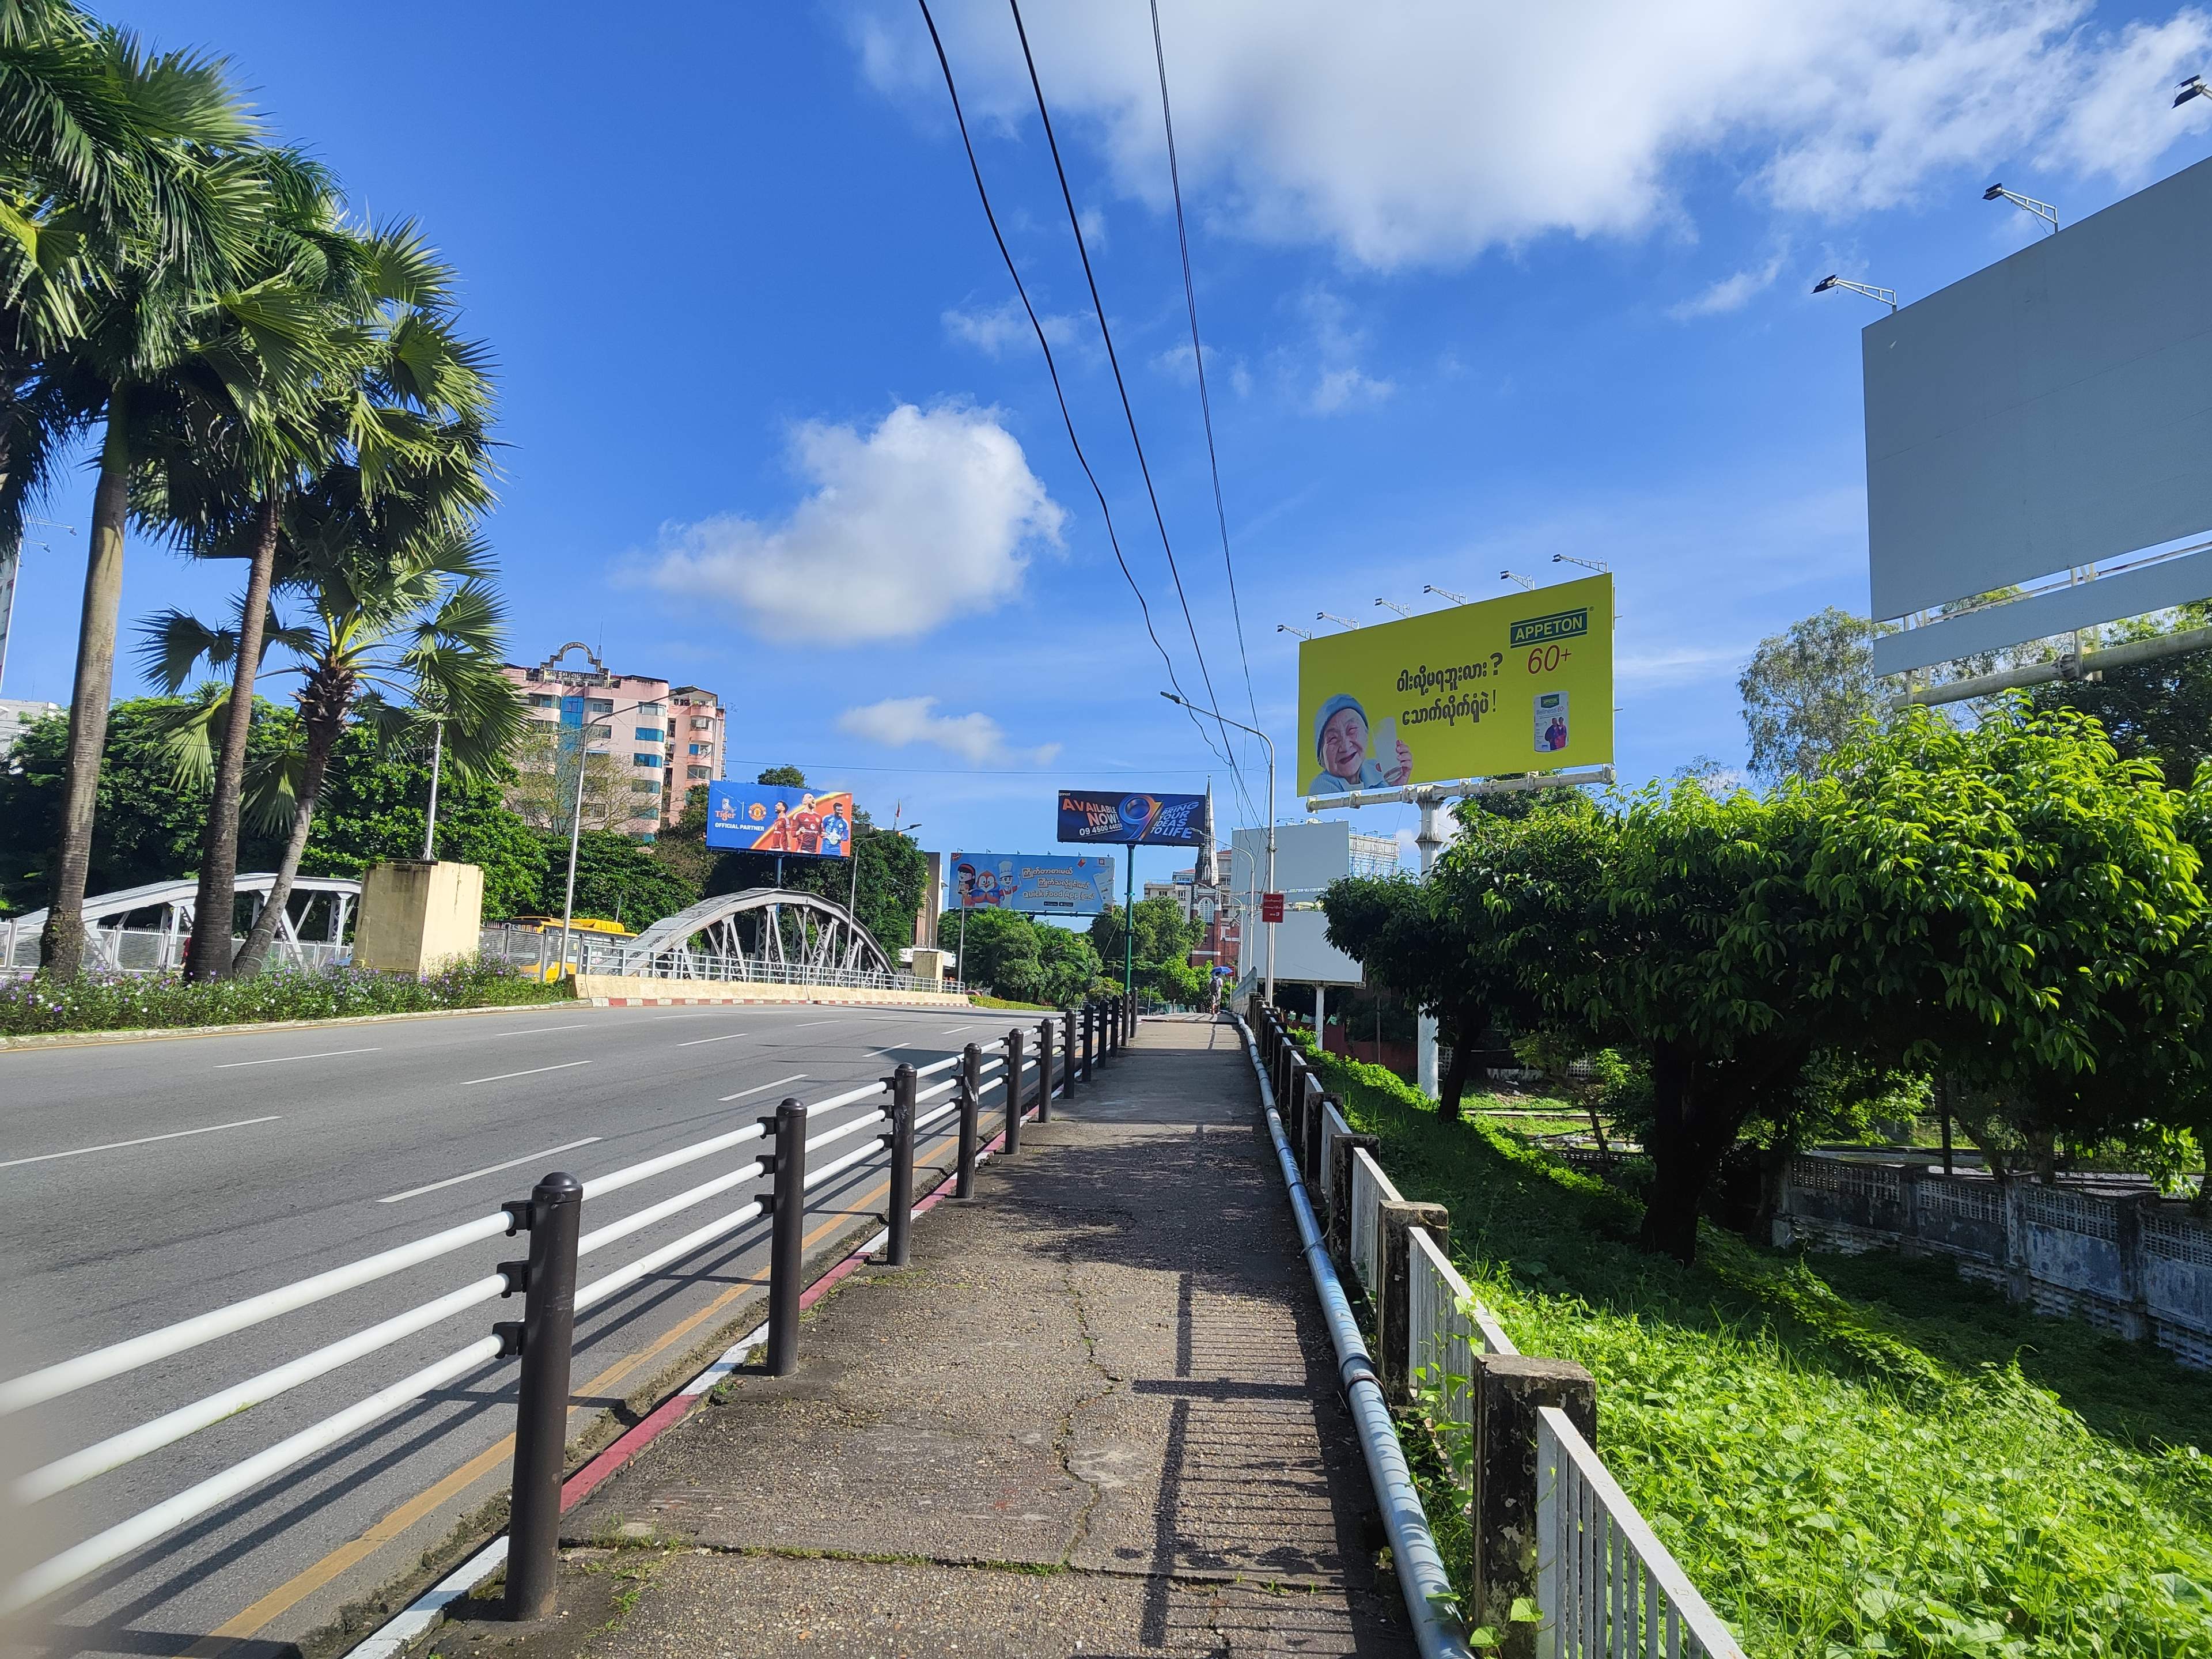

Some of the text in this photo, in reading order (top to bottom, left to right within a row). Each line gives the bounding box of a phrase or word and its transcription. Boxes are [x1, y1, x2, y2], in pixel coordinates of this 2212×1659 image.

[1515, 616, 1583, 641] APPETON
[1528, 645, 1572, 675] 60+
[1062, 798, 1117, 813] AVAILABLE
[1161, 801, 1199, 815] BRING
[714, 810, 736, 821] Tiger
[1086, 812, 1120, 827] NOW!
[1158, 810, 1190, 821] YOUR
[1153, 818, 1188, 827] IDEAS
[1079, 827, 1090, 836] 09
[1091, 825, 1108, 834] 4500
[1150, 827, 1192, 839] TO LIFE
[1063, 891, 1079, 900] App
